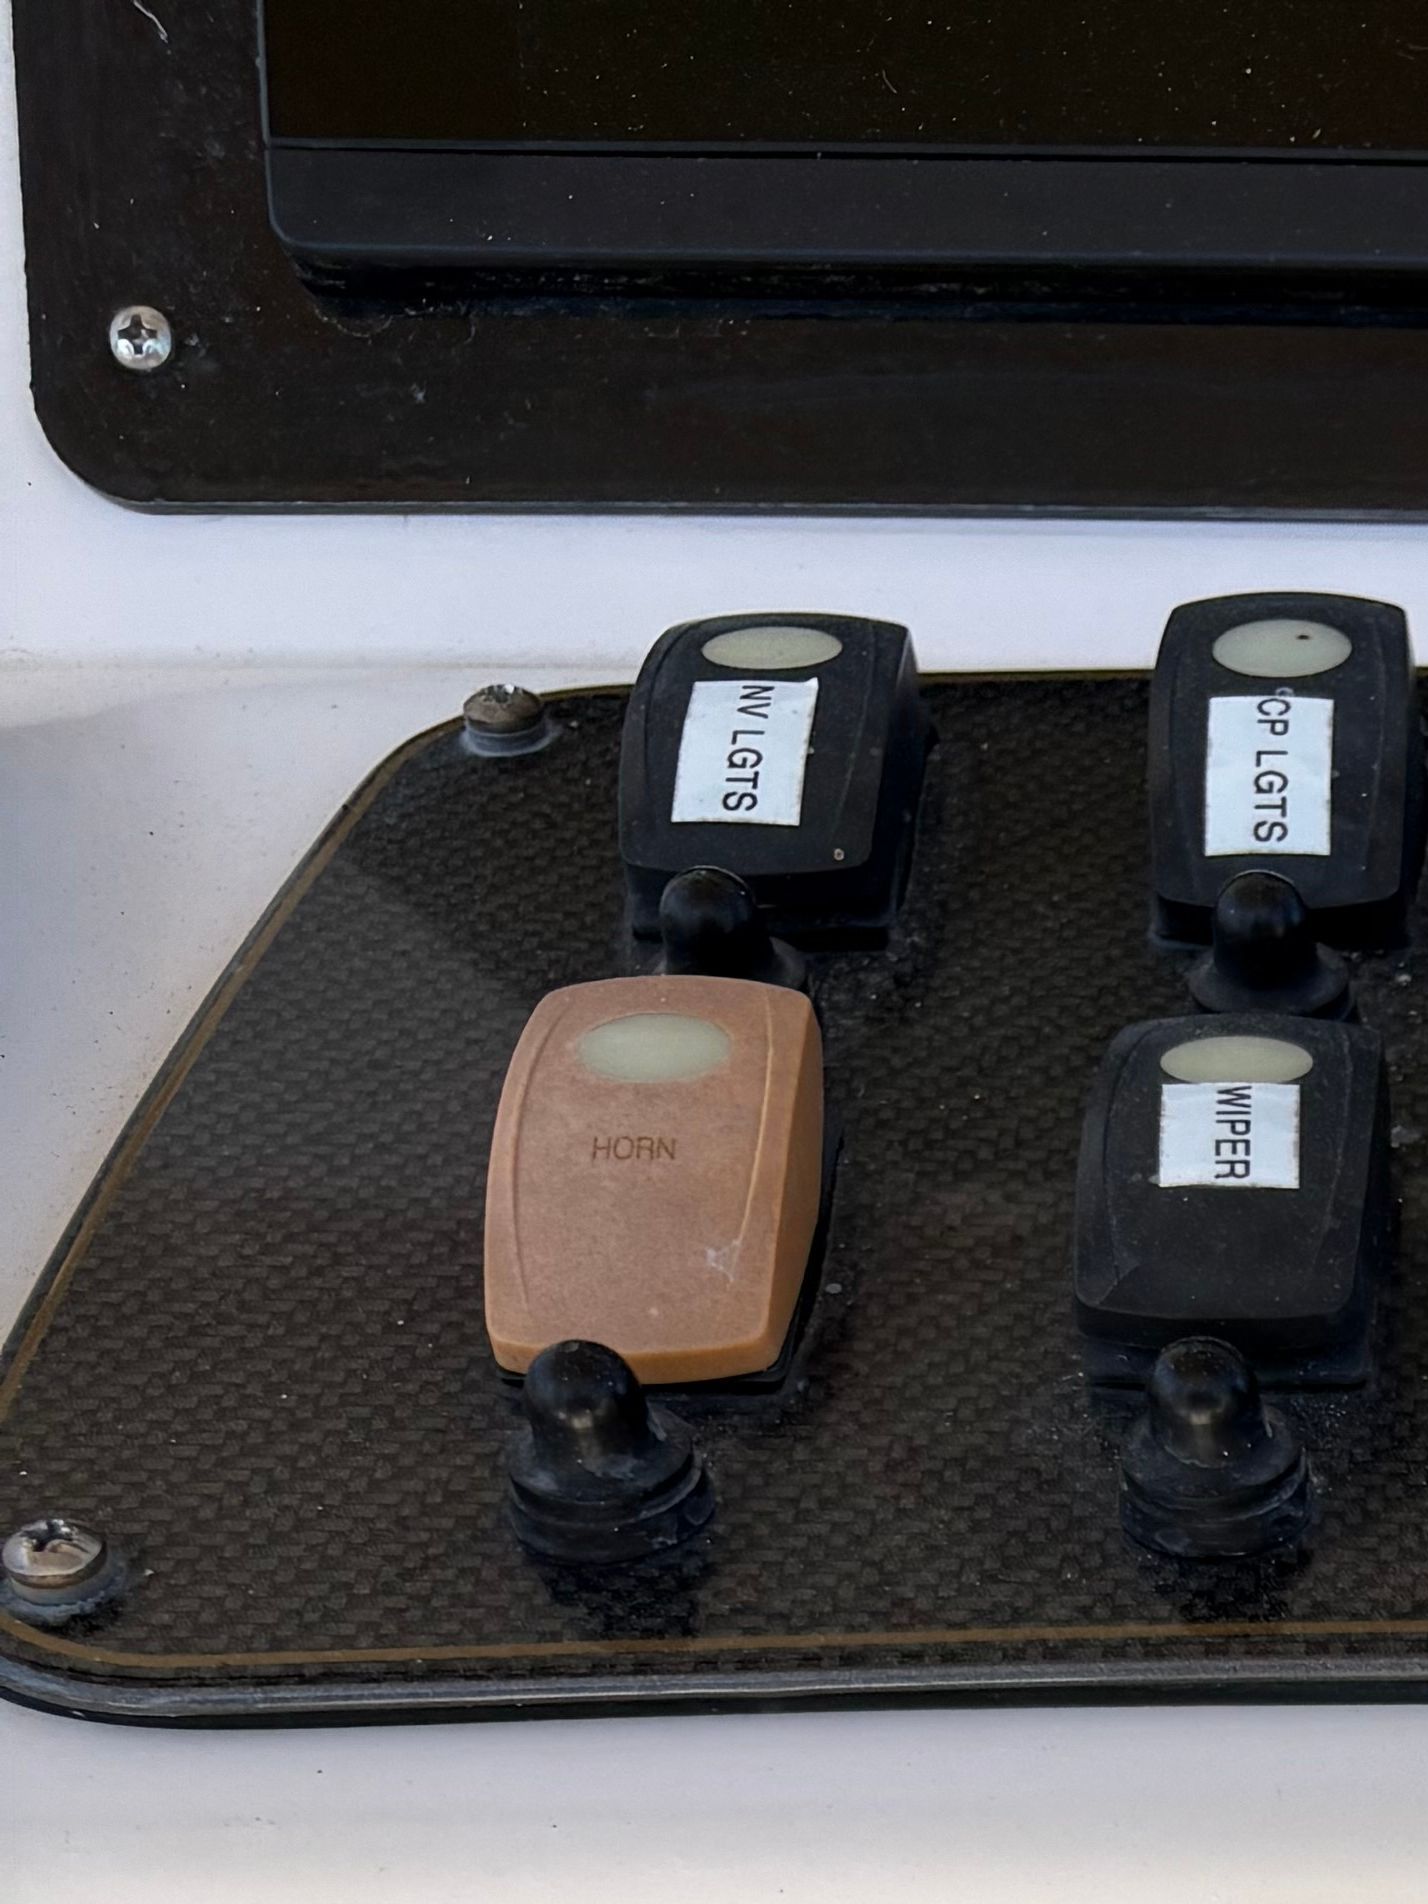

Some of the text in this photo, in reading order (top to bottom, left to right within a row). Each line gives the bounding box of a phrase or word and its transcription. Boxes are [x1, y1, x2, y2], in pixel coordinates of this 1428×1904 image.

[722, 685, 775, 812] NV LGTS
[1253, 698, 1291, 842] CP LGTS
[591, 1135, 677, 1163] HORN
[1214, 1085, 1253, 1180] WIPER
